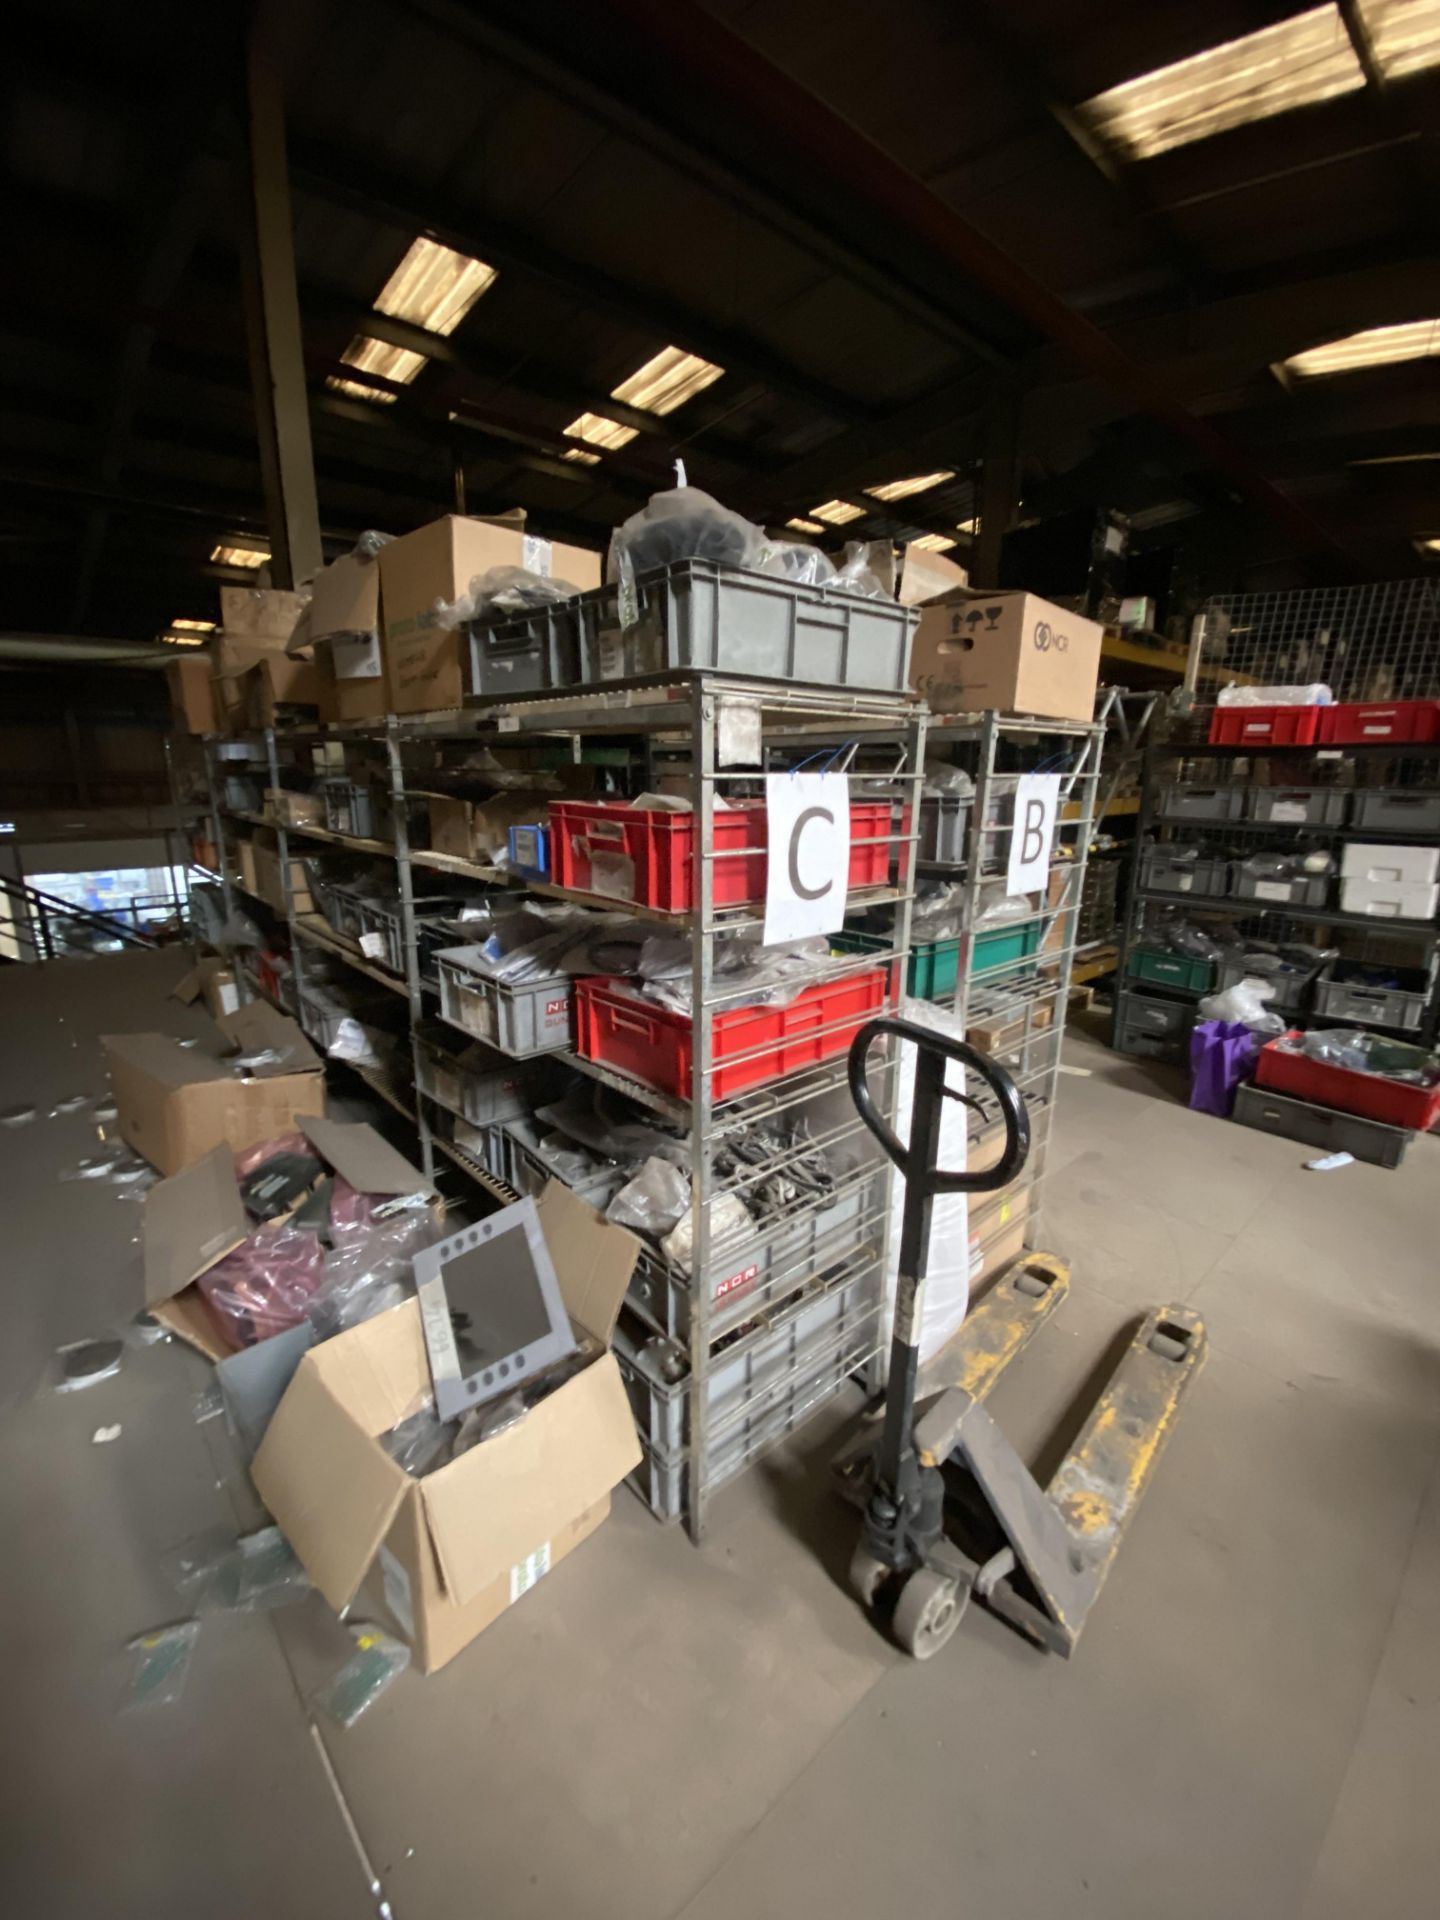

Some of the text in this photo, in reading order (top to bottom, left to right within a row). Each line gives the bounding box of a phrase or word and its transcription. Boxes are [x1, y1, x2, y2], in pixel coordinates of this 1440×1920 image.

[1052, 635, 1069, 653] NCR
[788, 806, 834, 900] C
[1020, 799, 1046, 865] B
